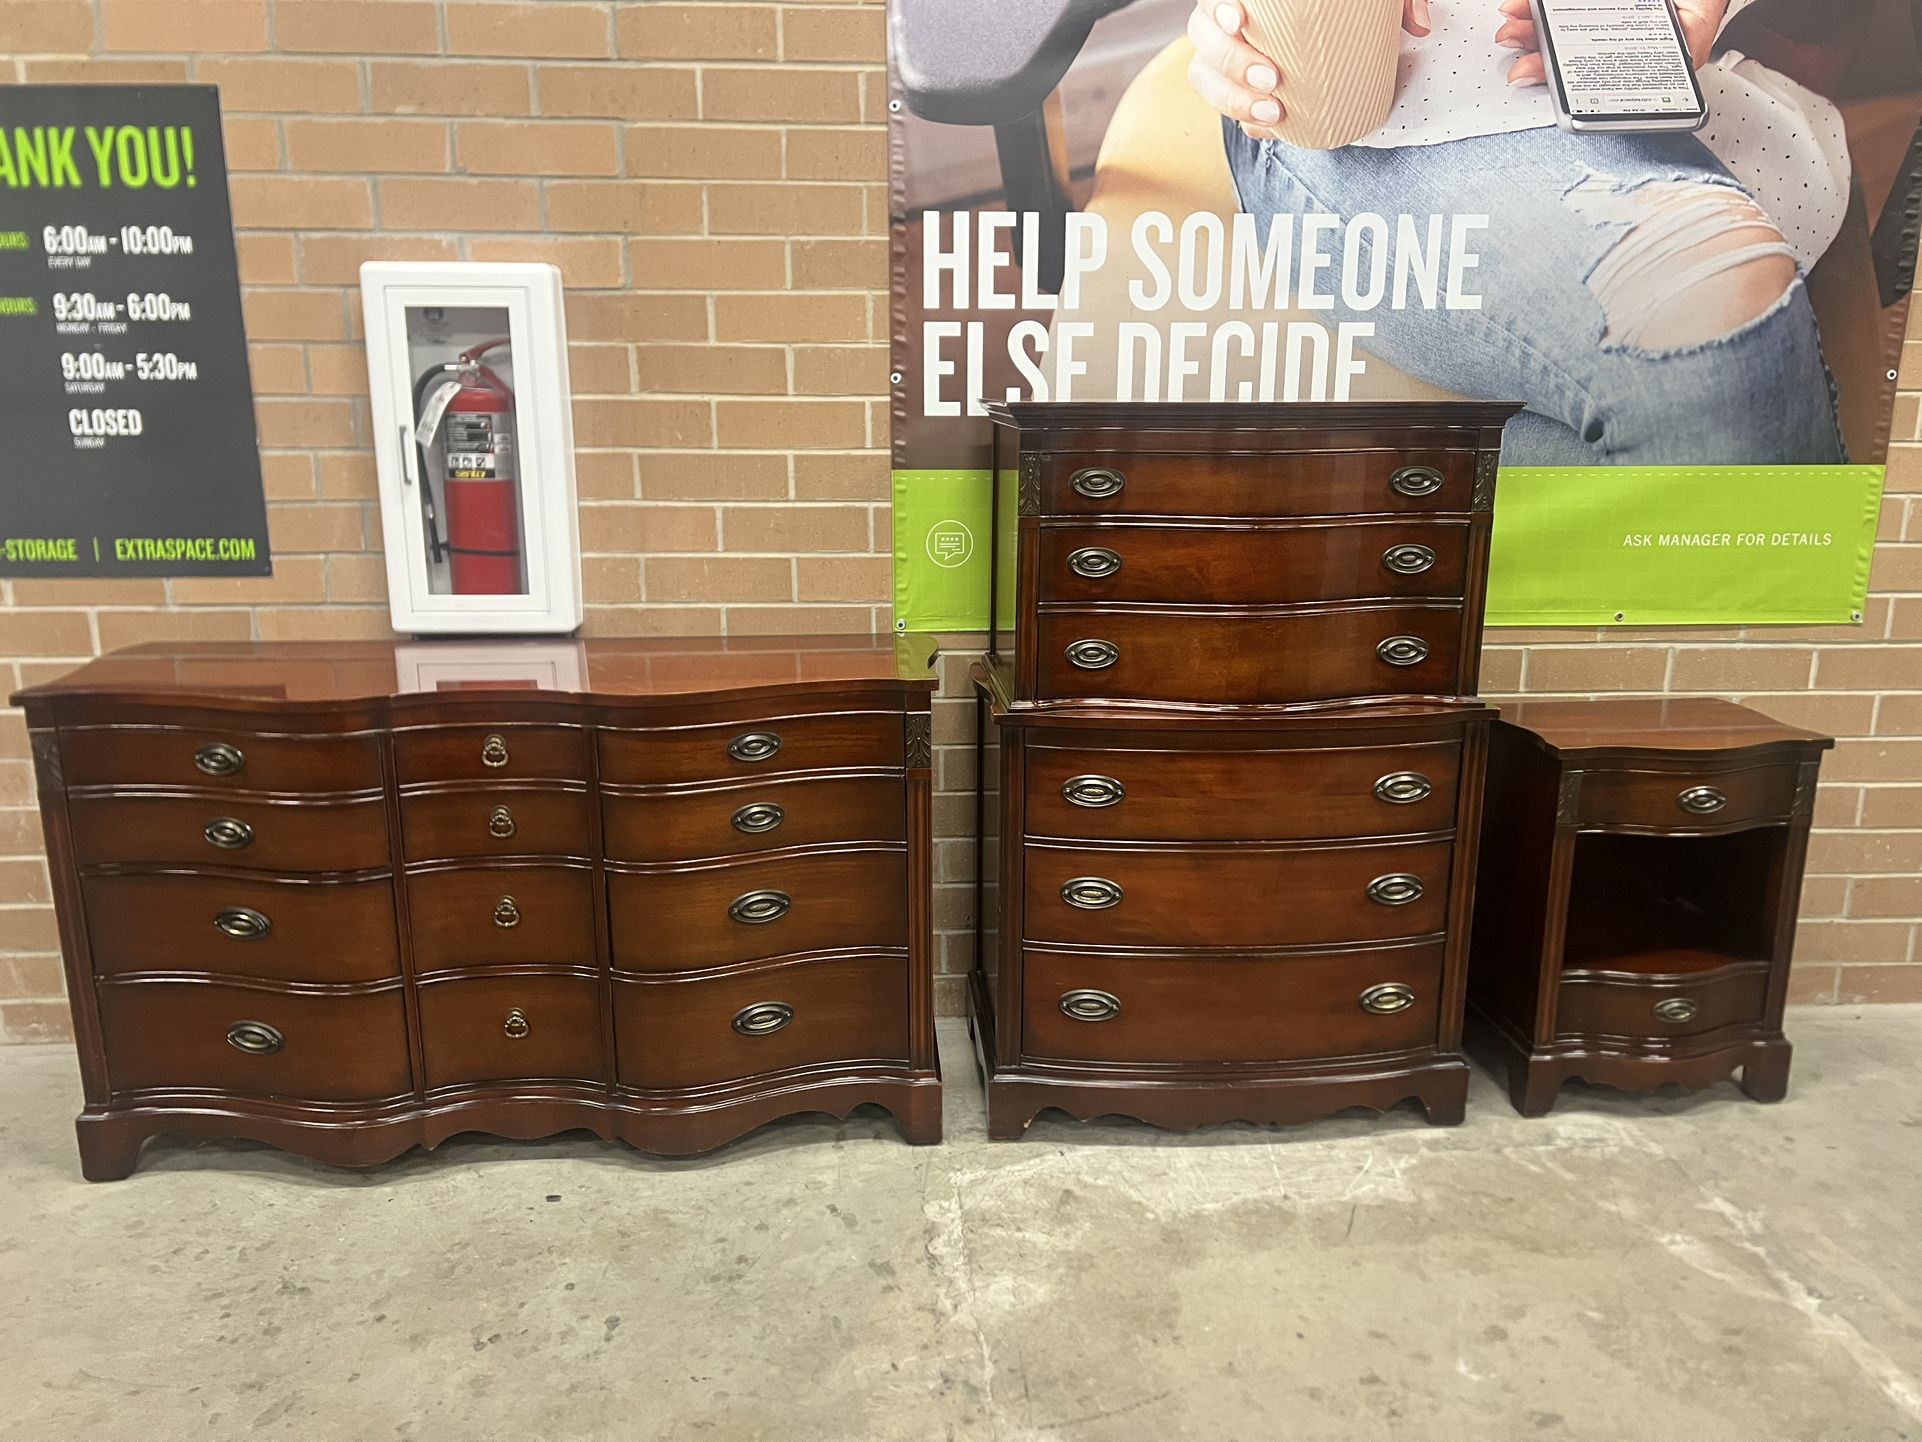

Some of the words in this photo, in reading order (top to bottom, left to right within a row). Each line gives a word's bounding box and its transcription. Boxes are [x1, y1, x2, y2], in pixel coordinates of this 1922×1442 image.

[84, 125, 197, 188] YOU!
[923, 210, 1108, 309] HELP
[1128, 212, 1490, 310] SOMEONE
[923, 320, 1097, 416] ELSE
[1115, 322, 1376, 401] DECIDE
[68, 409, 143, 436] CLOSED
[115, 538, 256, 562] EXTRASPACE.COM
[1623, 534, 1652, 547] ASK
[1658, 533, 1731, 546] MANAGER
[1736, 533, 1765, 546] FOR
[1771, 533, 1832, 546] DETAILS
